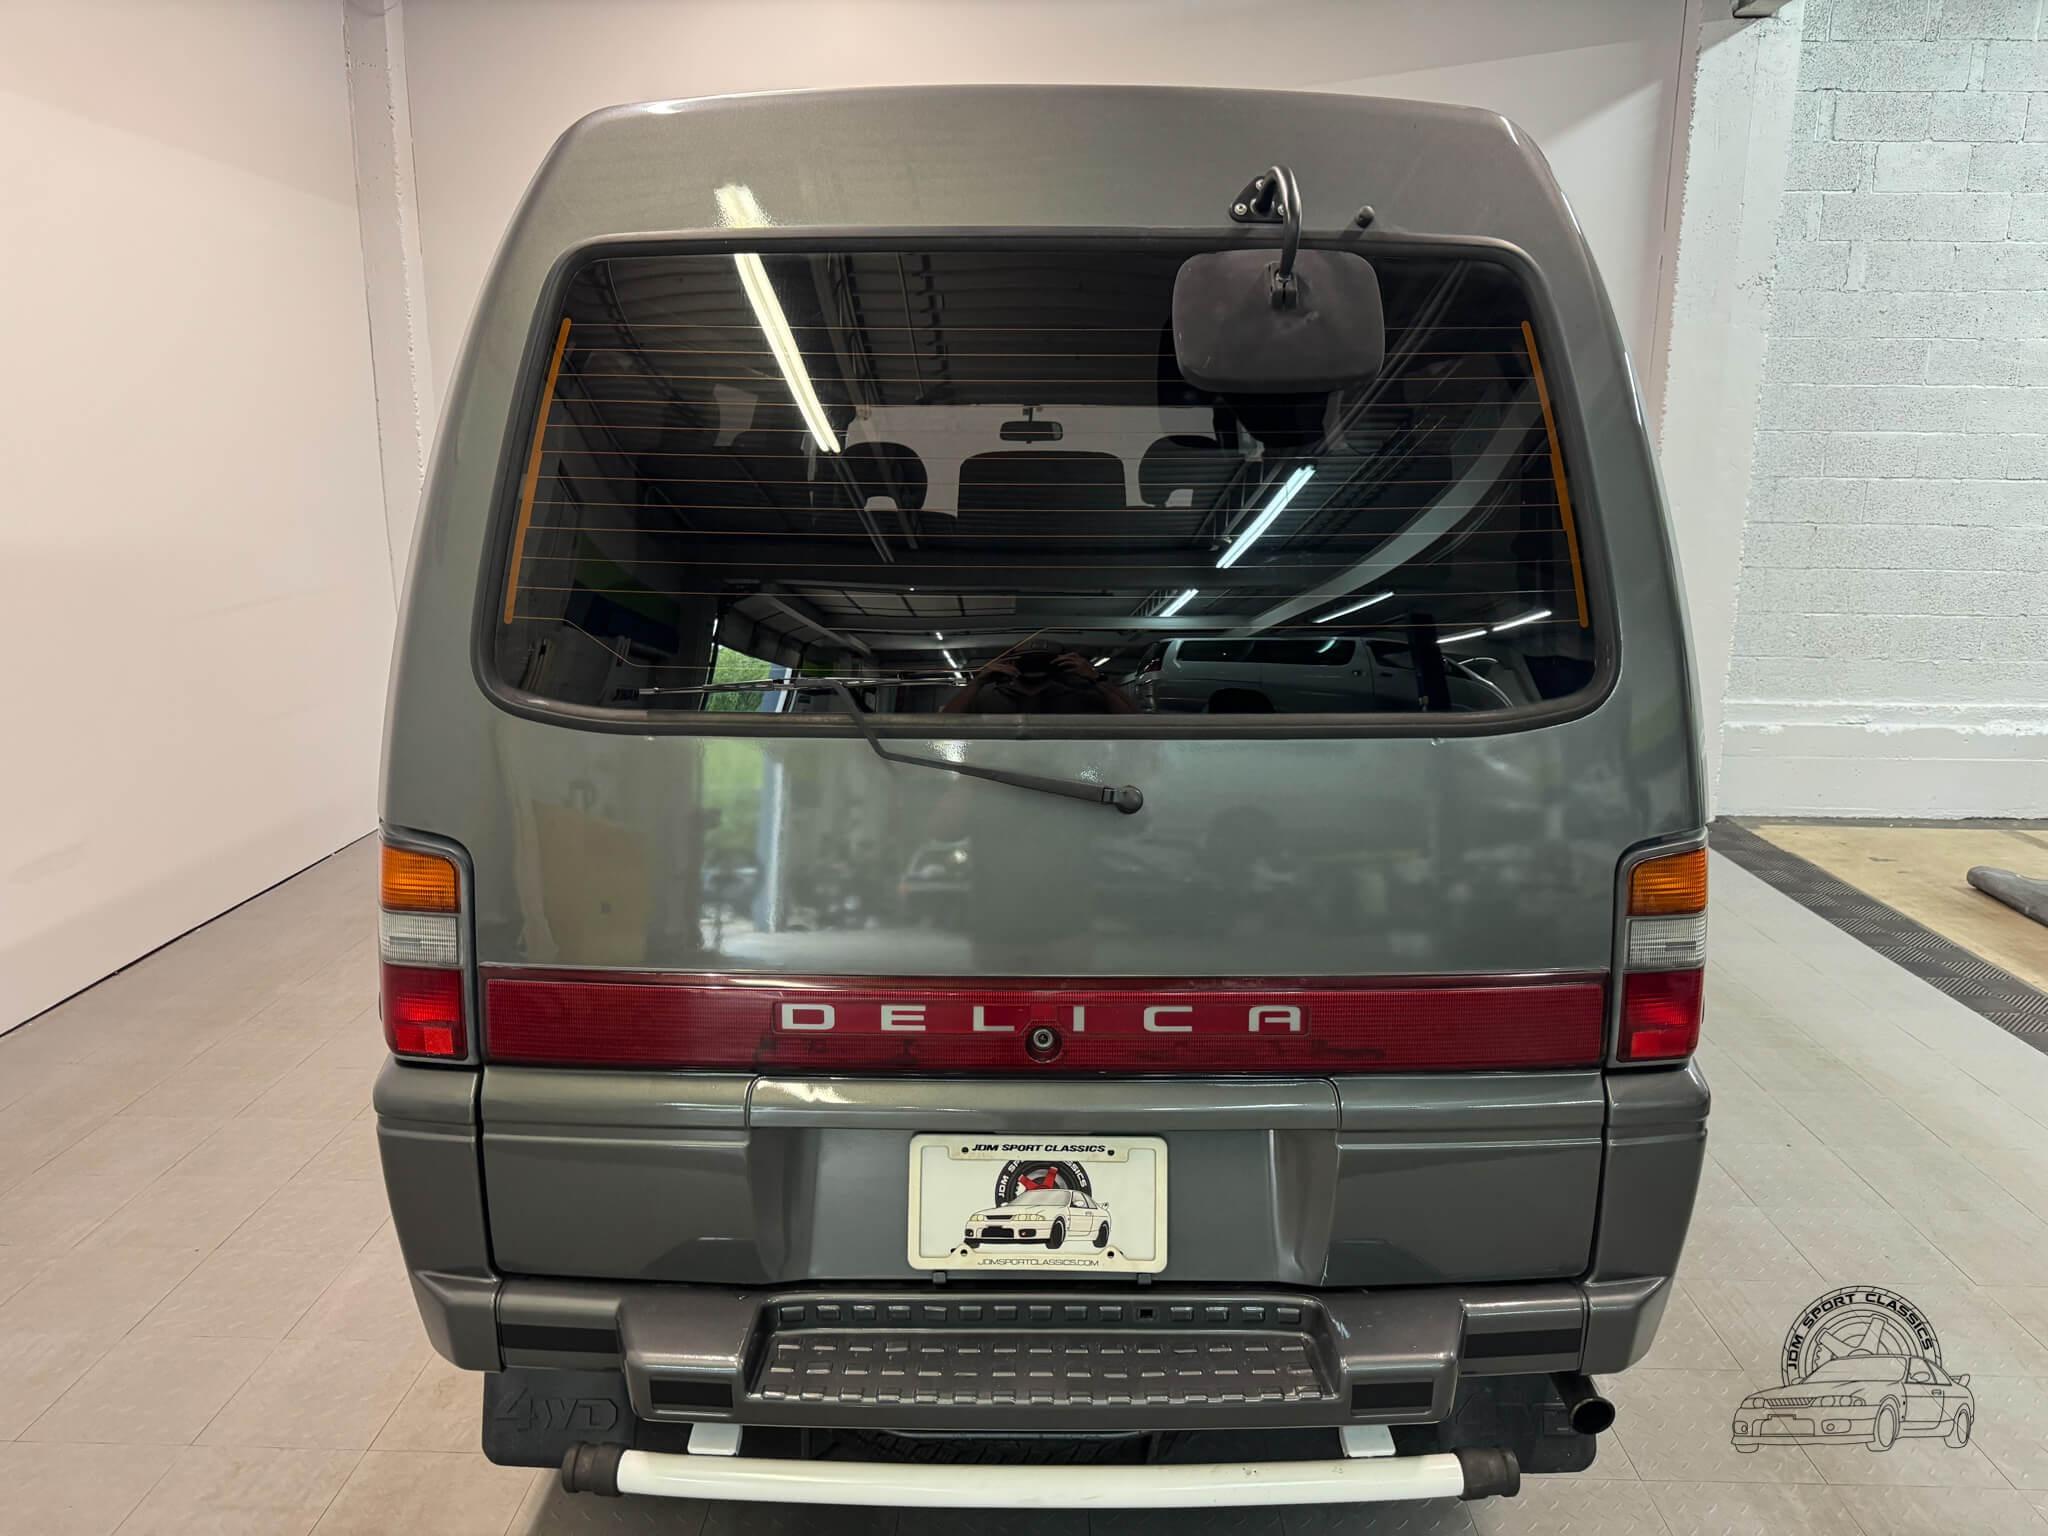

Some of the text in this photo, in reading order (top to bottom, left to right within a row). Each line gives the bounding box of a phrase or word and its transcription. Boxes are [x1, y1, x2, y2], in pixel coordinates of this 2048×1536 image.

[780, 1003, 1302, 1033] DELICA
[972, 1144, 1106, 1153] JDM SPORT CLASSICS
[998, 1175, 1009, 1198] JDM
[977, 1258, 1100, 1267] JDMSPORTCLASSICS.COM
